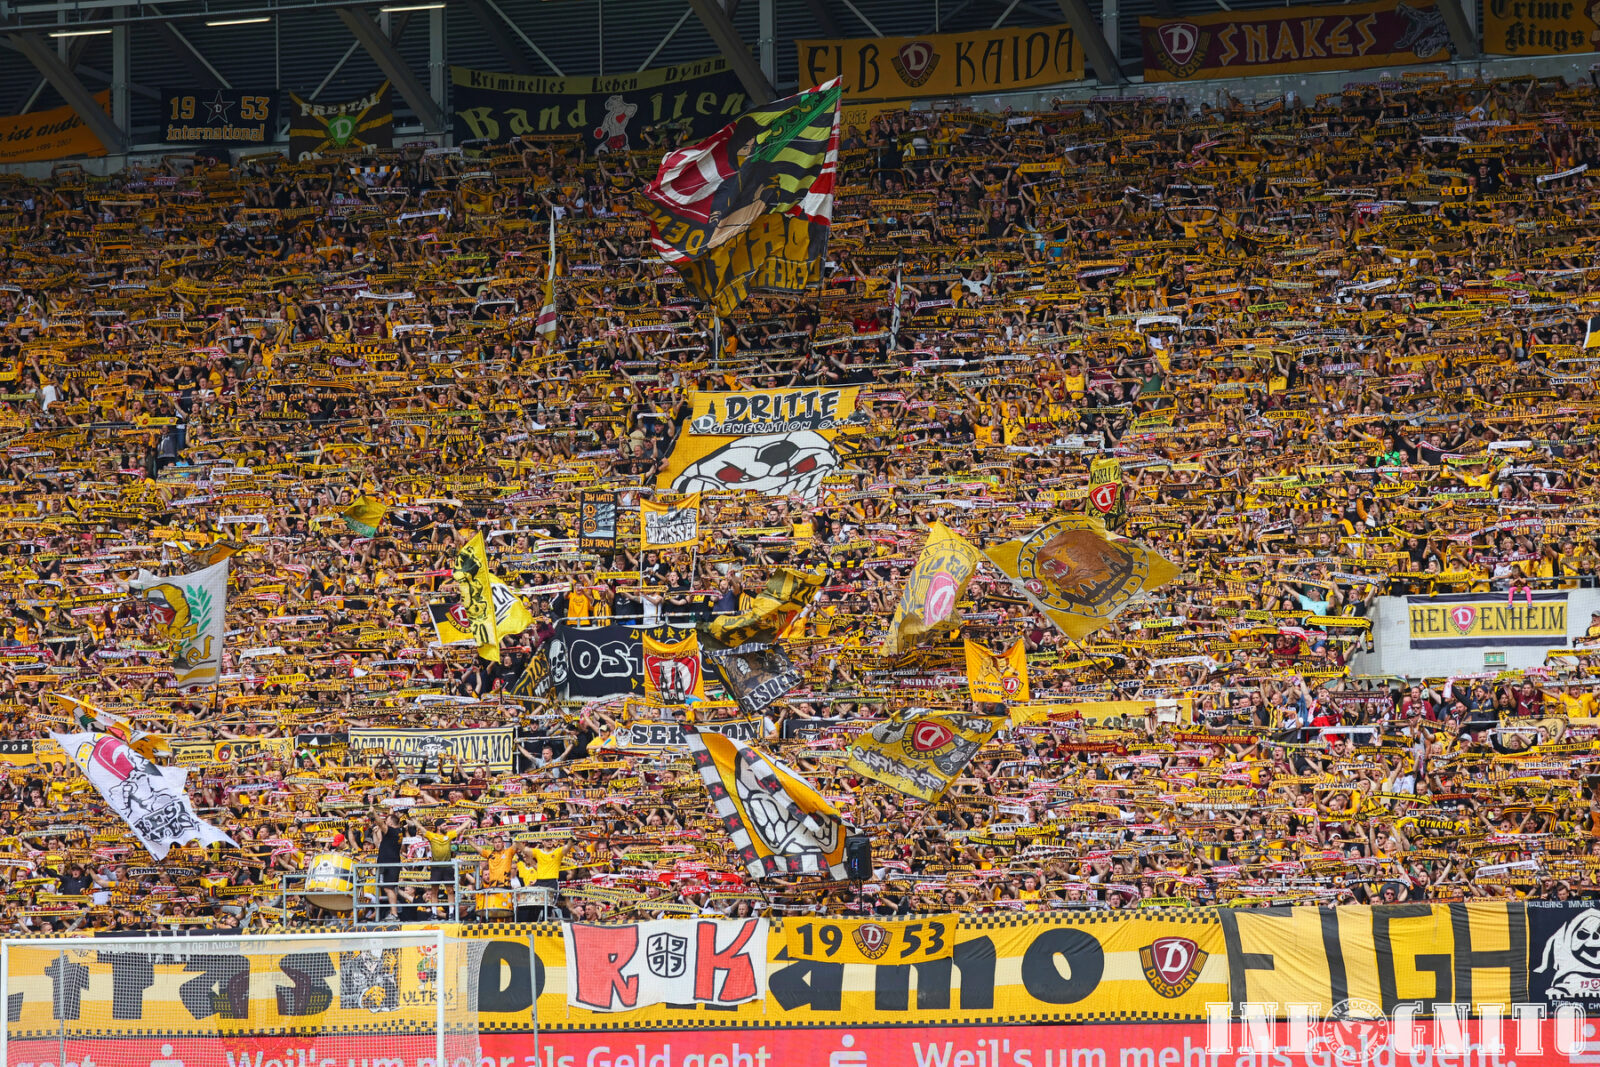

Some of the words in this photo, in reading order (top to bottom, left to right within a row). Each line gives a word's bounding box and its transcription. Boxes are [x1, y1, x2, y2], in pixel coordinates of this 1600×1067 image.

[1491, 0, 1575, 21] Crime
[1218, 13, 1377, 65] SNAKES
[1505, 22, 1585, 52] Kings
[807, 42, 880, 94] ELB
[955, 29, 1074, 88] KAIDA
[470, 70, 566, 94] Kriminelles
[592, 76, 638, 92] Leben
[170, 96, 196, 120] 19
[241, 96, 270, 120] 53
[301, 93, 381, 117] FREITAL
[456, 99, 588, 140] Band
[167, 124, 265, 141] international
[366, 353, 396, 361] DYNAMO
[72, 371, 100, 379] DYNAMO
[725, 389, 841, 421] DRITTE
[447, 434, 473, 443] DYNAMO
[710, 420, 811, 434] GENERATION
[1264, 489, 1296, 497] DRESDEN
[1286, 576, 1322, 585] DYNAMO
[1076, 684, 1097, 692] EAST
[1118, 680, 1140, 689] CREW
[37, 713, 70, 723] BRIGADE
[450, 734, 512, 768] DYNAMO
[1420, 820, 1454, 830] DYNAMO
[1569, 900, 1595, 908] IMMER
[797, 923, 843, 957] 19
[901, 922, 945, 959] 53
[857, 941, 889, 960] DRESDEN
[571, 922, 639, 1009] R
[694, 917, 759, 1001] K
[1145, 965, 1200, 1000] DRESDEN
[524, 1045, 575, 1067] als
[586, 1043, 671, 1067] Geld
[683, 1042, 771, 1067] geht
[912, 1038, 1032, 1067] Weil's
[1045, 1046, 1106, 1067] um
[1119, 1036, 1222, 1067] mehr
[1242, 1036, 1293, 1067] als
[1305, 1035, 1395, 1067] Geld
